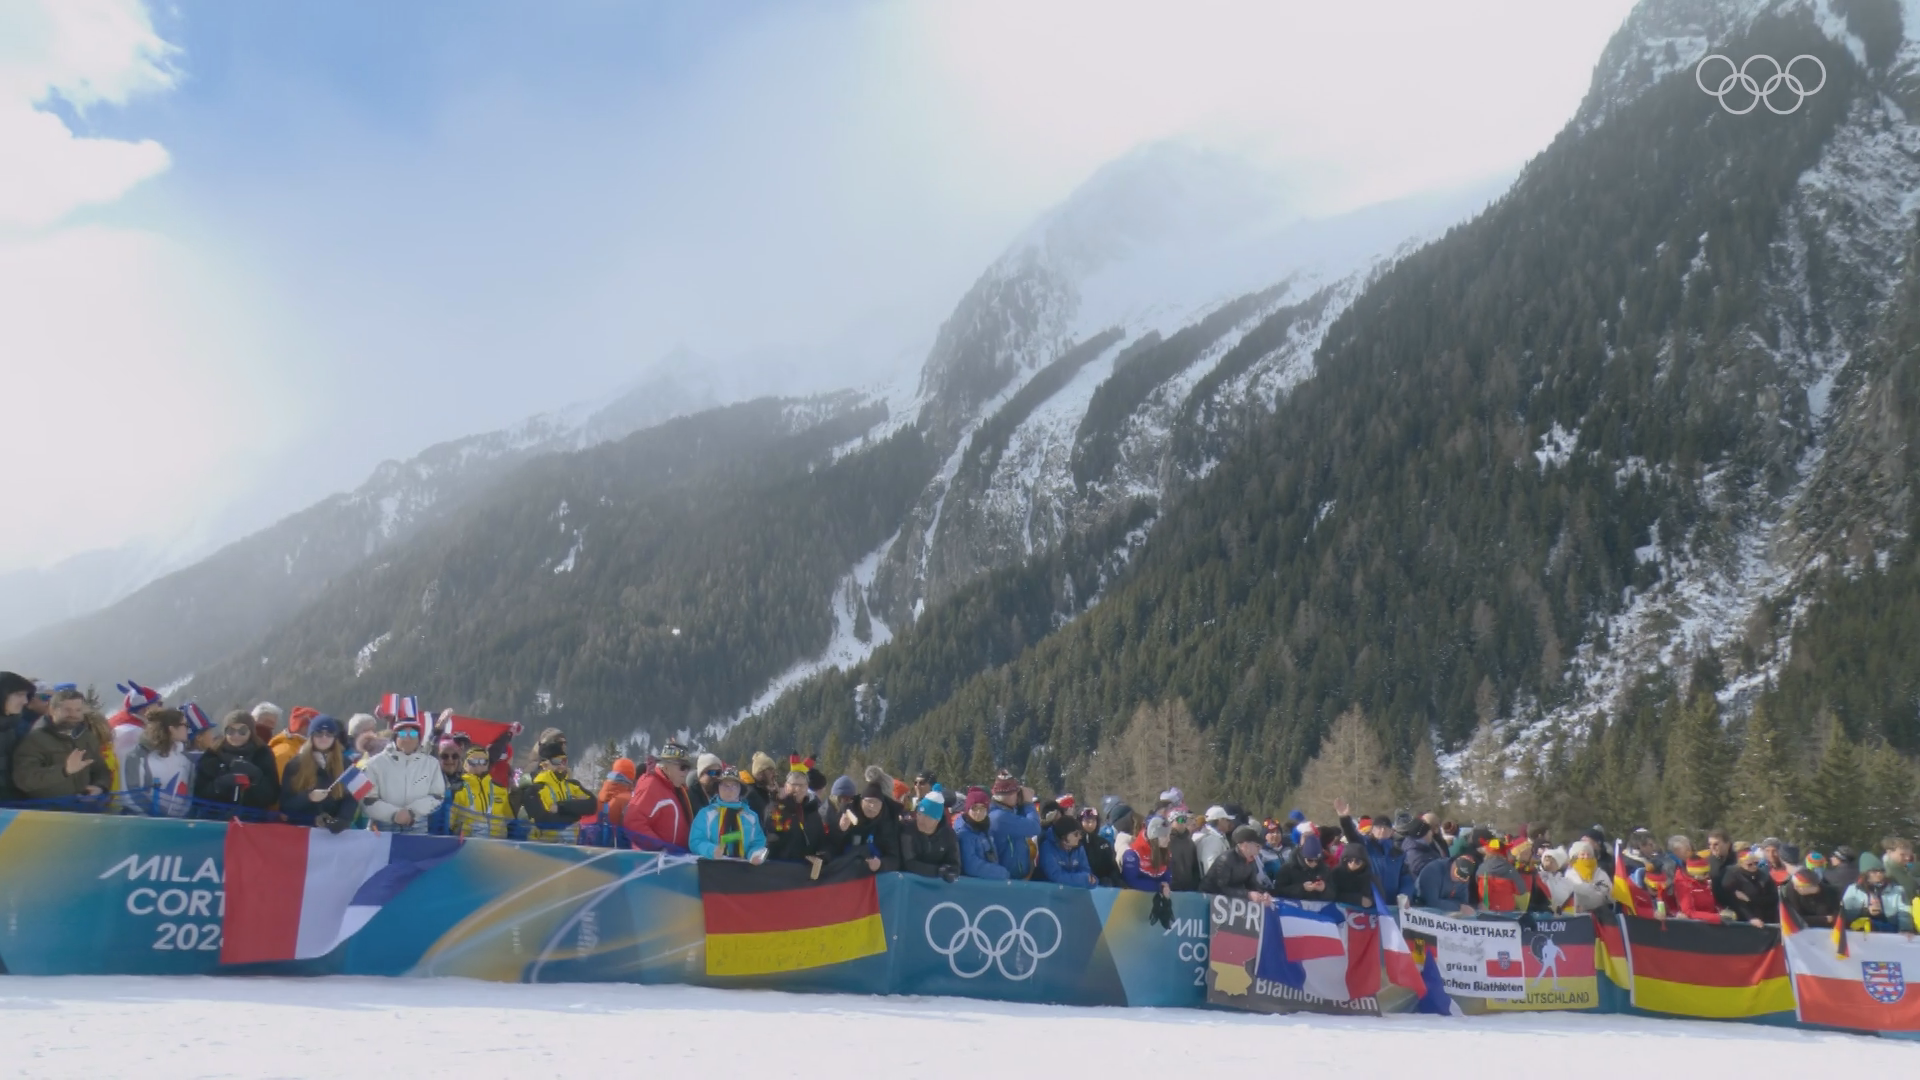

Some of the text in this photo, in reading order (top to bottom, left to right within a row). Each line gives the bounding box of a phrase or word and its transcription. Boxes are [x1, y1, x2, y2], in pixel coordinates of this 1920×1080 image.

[98, 854, 226, 883] MILA
[152, 922, 224, 951] 202
[1404, 911, 1516, 939] TAMBACH-DIETHARZ
